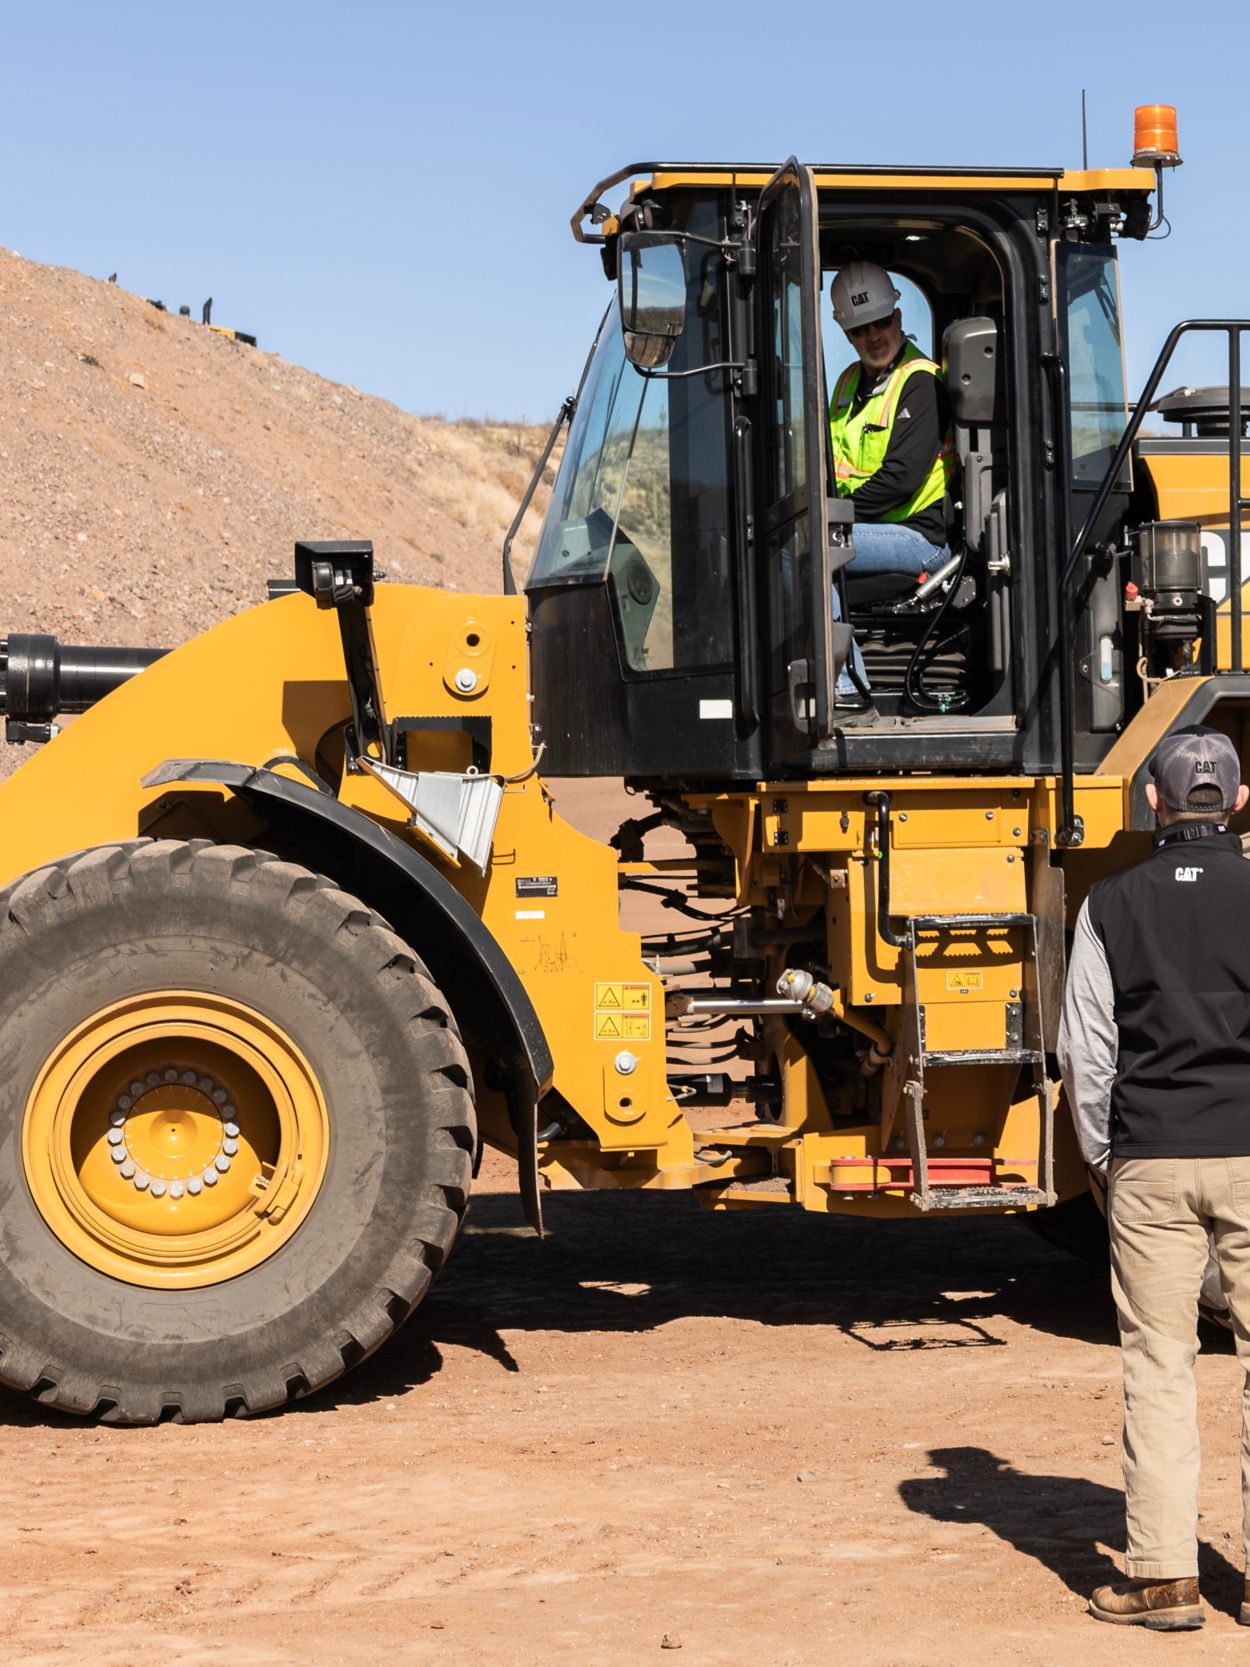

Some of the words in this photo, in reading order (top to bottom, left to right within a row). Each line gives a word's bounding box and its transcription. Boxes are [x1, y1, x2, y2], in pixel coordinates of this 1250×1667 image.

[851, 291, 869, 306] CAT
[1195, 761, 1217, 773] CAT
[1175, 867, 1199, 882] CAT
